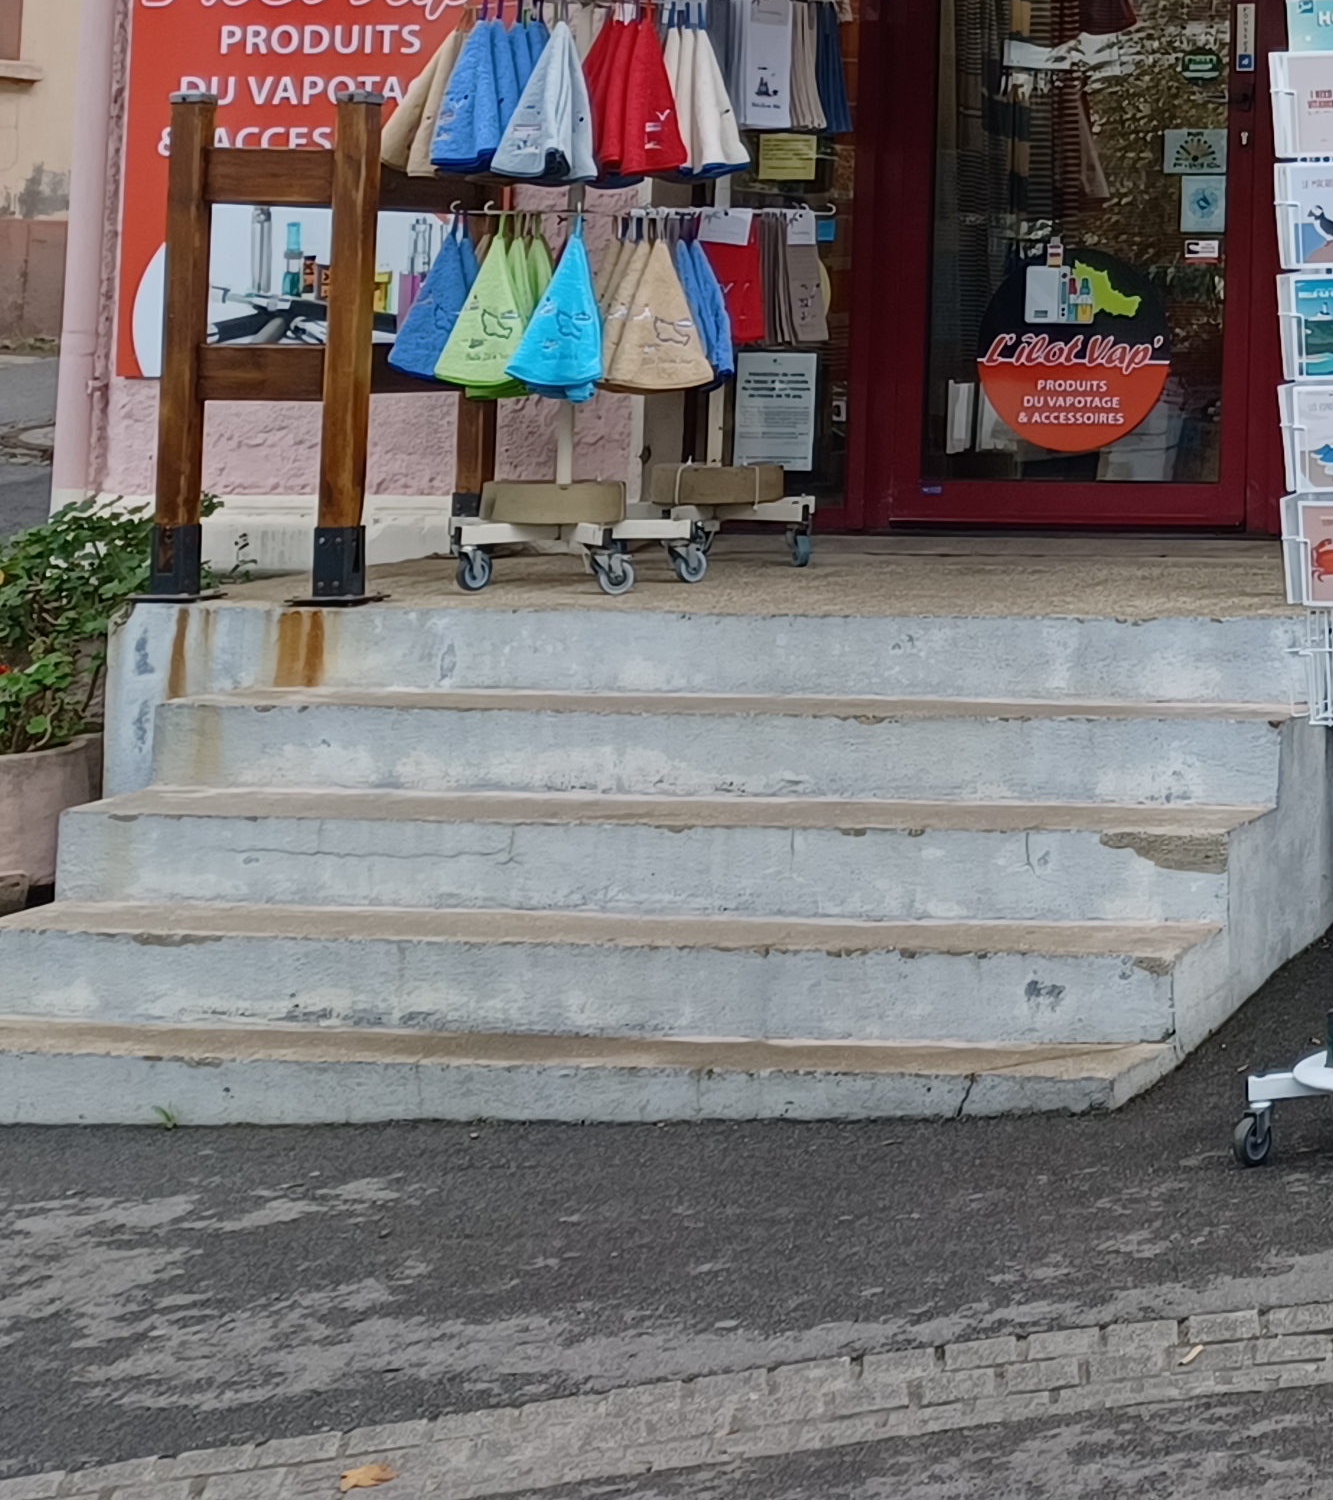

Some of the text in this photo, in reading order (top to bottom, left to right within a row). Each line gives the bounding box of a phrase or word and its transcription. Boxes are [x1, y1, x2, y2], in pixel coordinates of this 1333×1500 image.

[220, 24, 422, 54] PRODUITS
[248, 76, 402, 106] VAPOTA
[983, 333, 1164, 375] L'îlot Vap'
[1037, 380, 1107, 392] PRODUITS
[1024, 396, 1120, 408] DU VAPOTAGE
[1017, 412, 1125, 425] & ACCESSOIRES
